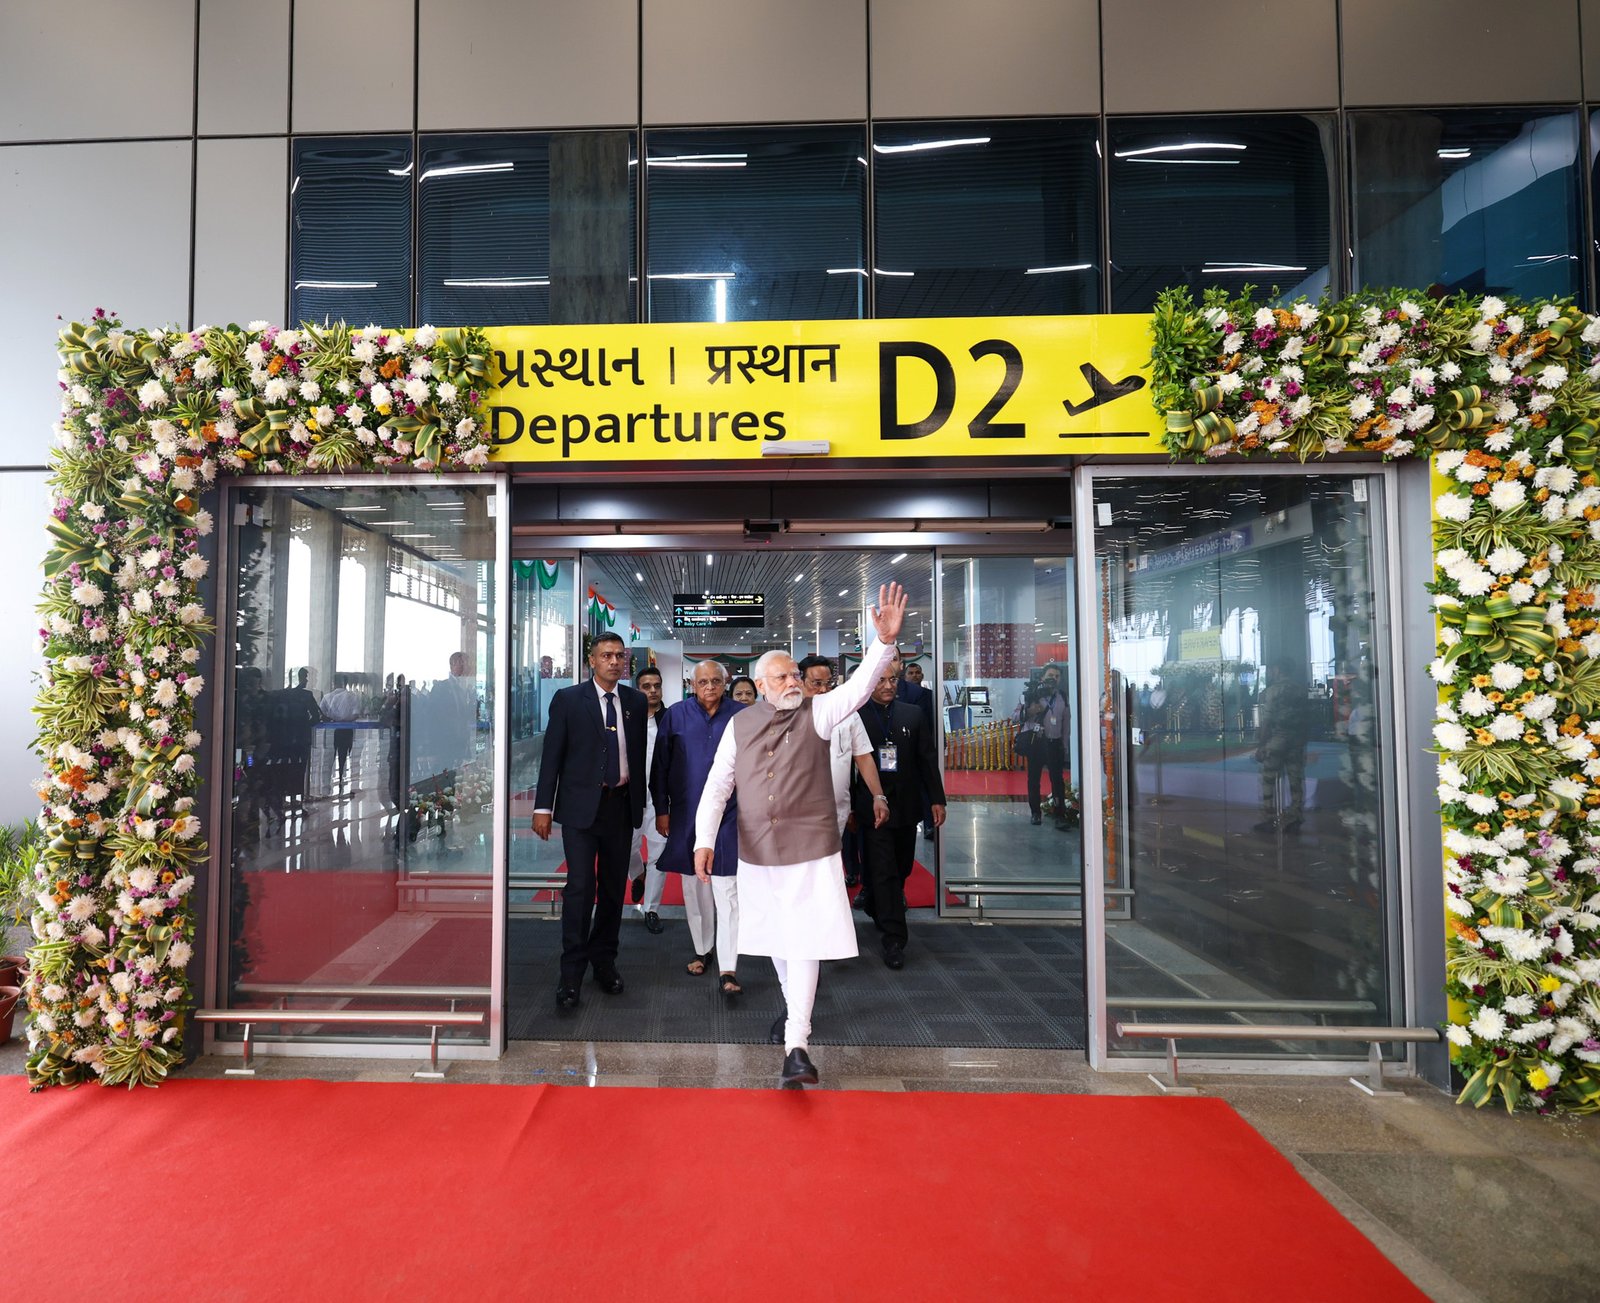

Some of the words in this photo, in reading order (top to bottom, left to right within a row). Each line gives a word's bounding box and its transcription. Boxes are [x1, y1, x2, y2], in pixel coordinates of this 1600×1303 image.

[492, 347, 645, 389] પ્રસ્થાન
[704, 344, 841, 385] प्रस्थान
[878, 338, 1027, 441] D2
[490, 404, 787, 458] Departures
